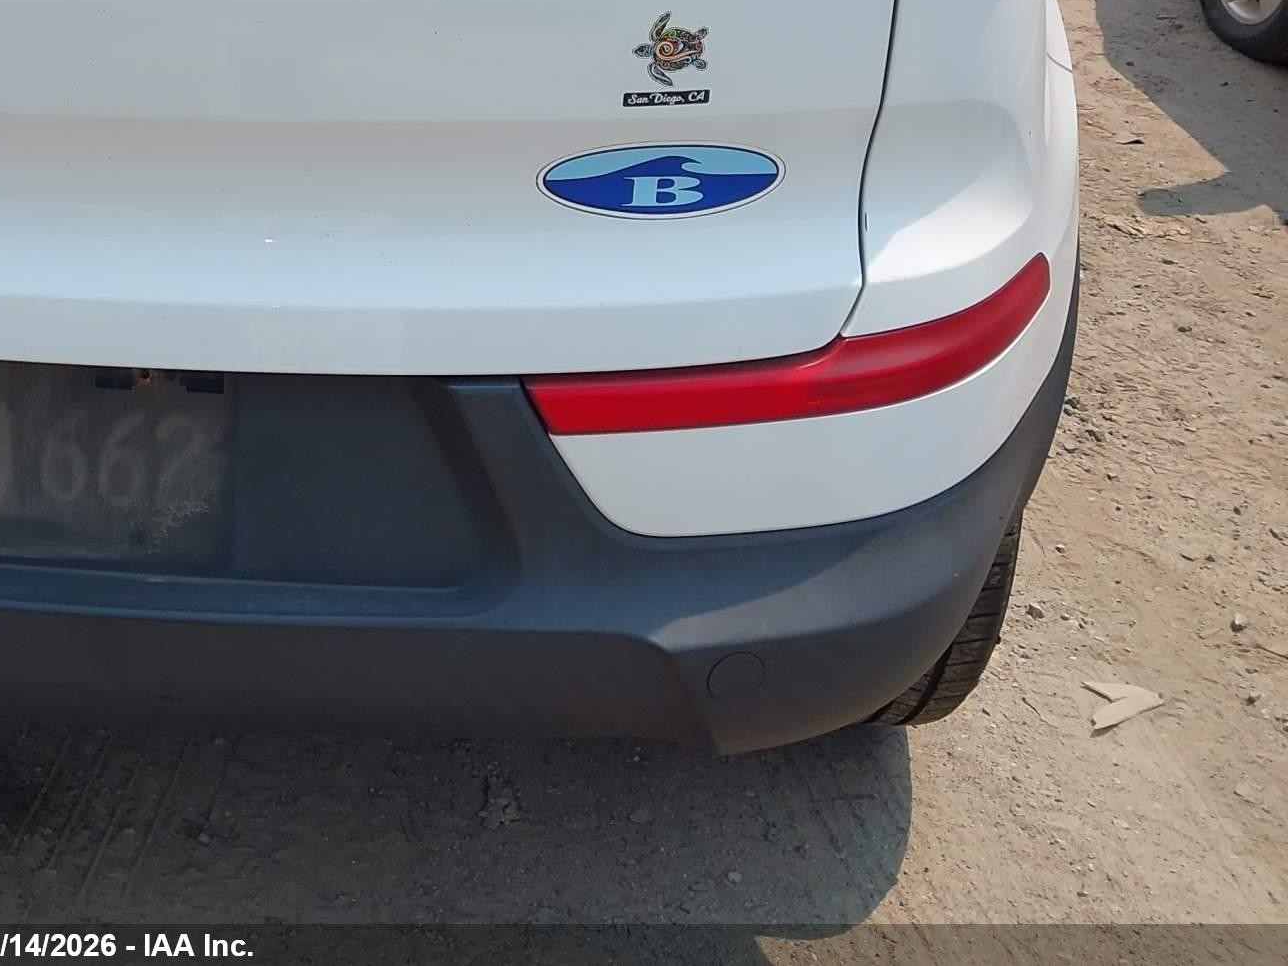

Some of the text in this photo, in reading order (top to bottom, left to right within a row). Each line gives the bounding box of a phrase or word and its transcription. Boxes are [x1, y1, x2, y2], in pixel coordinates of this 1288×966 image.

[627, 91, 705, 105] San Diego, CA
[620, 176, 704, 207] B
